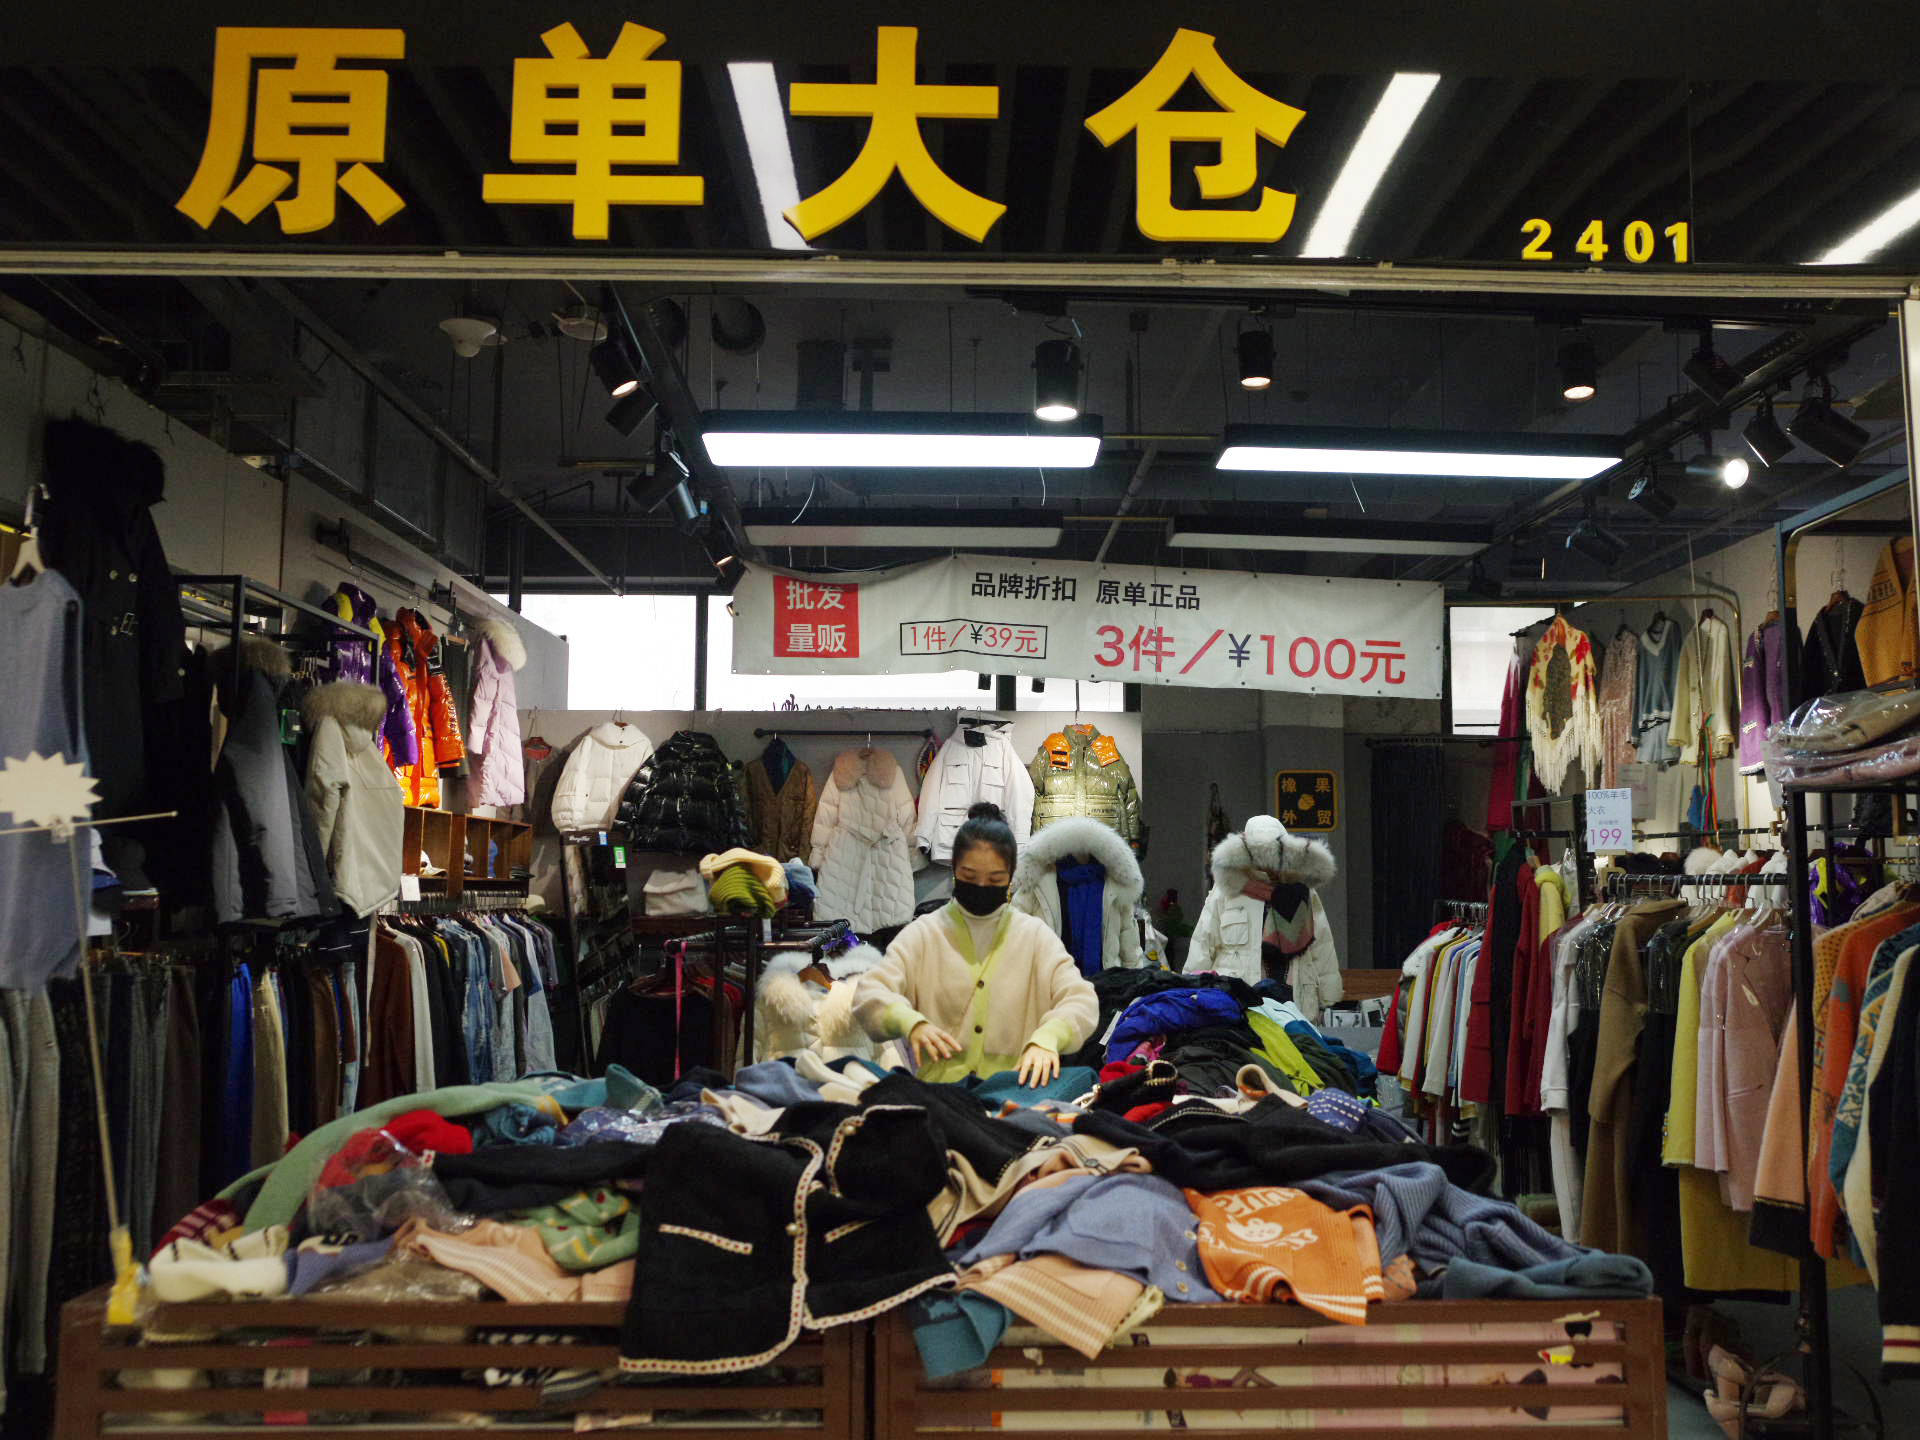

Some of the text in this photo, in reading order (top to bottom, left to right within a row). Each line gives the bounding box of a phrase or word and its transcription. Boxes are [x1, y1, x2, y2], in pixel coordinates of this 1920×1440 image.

[175, 21, 1306, 243] 原单大仓
[1521, 218, 1688, 263] 2401
[786, 581, 846, 610] 批发
[971, 572, 1201, 611] 品牌折扣 原单正品
[786, 623, 848, 653] 量贩
[1590, 828, 1622, 846] 199
